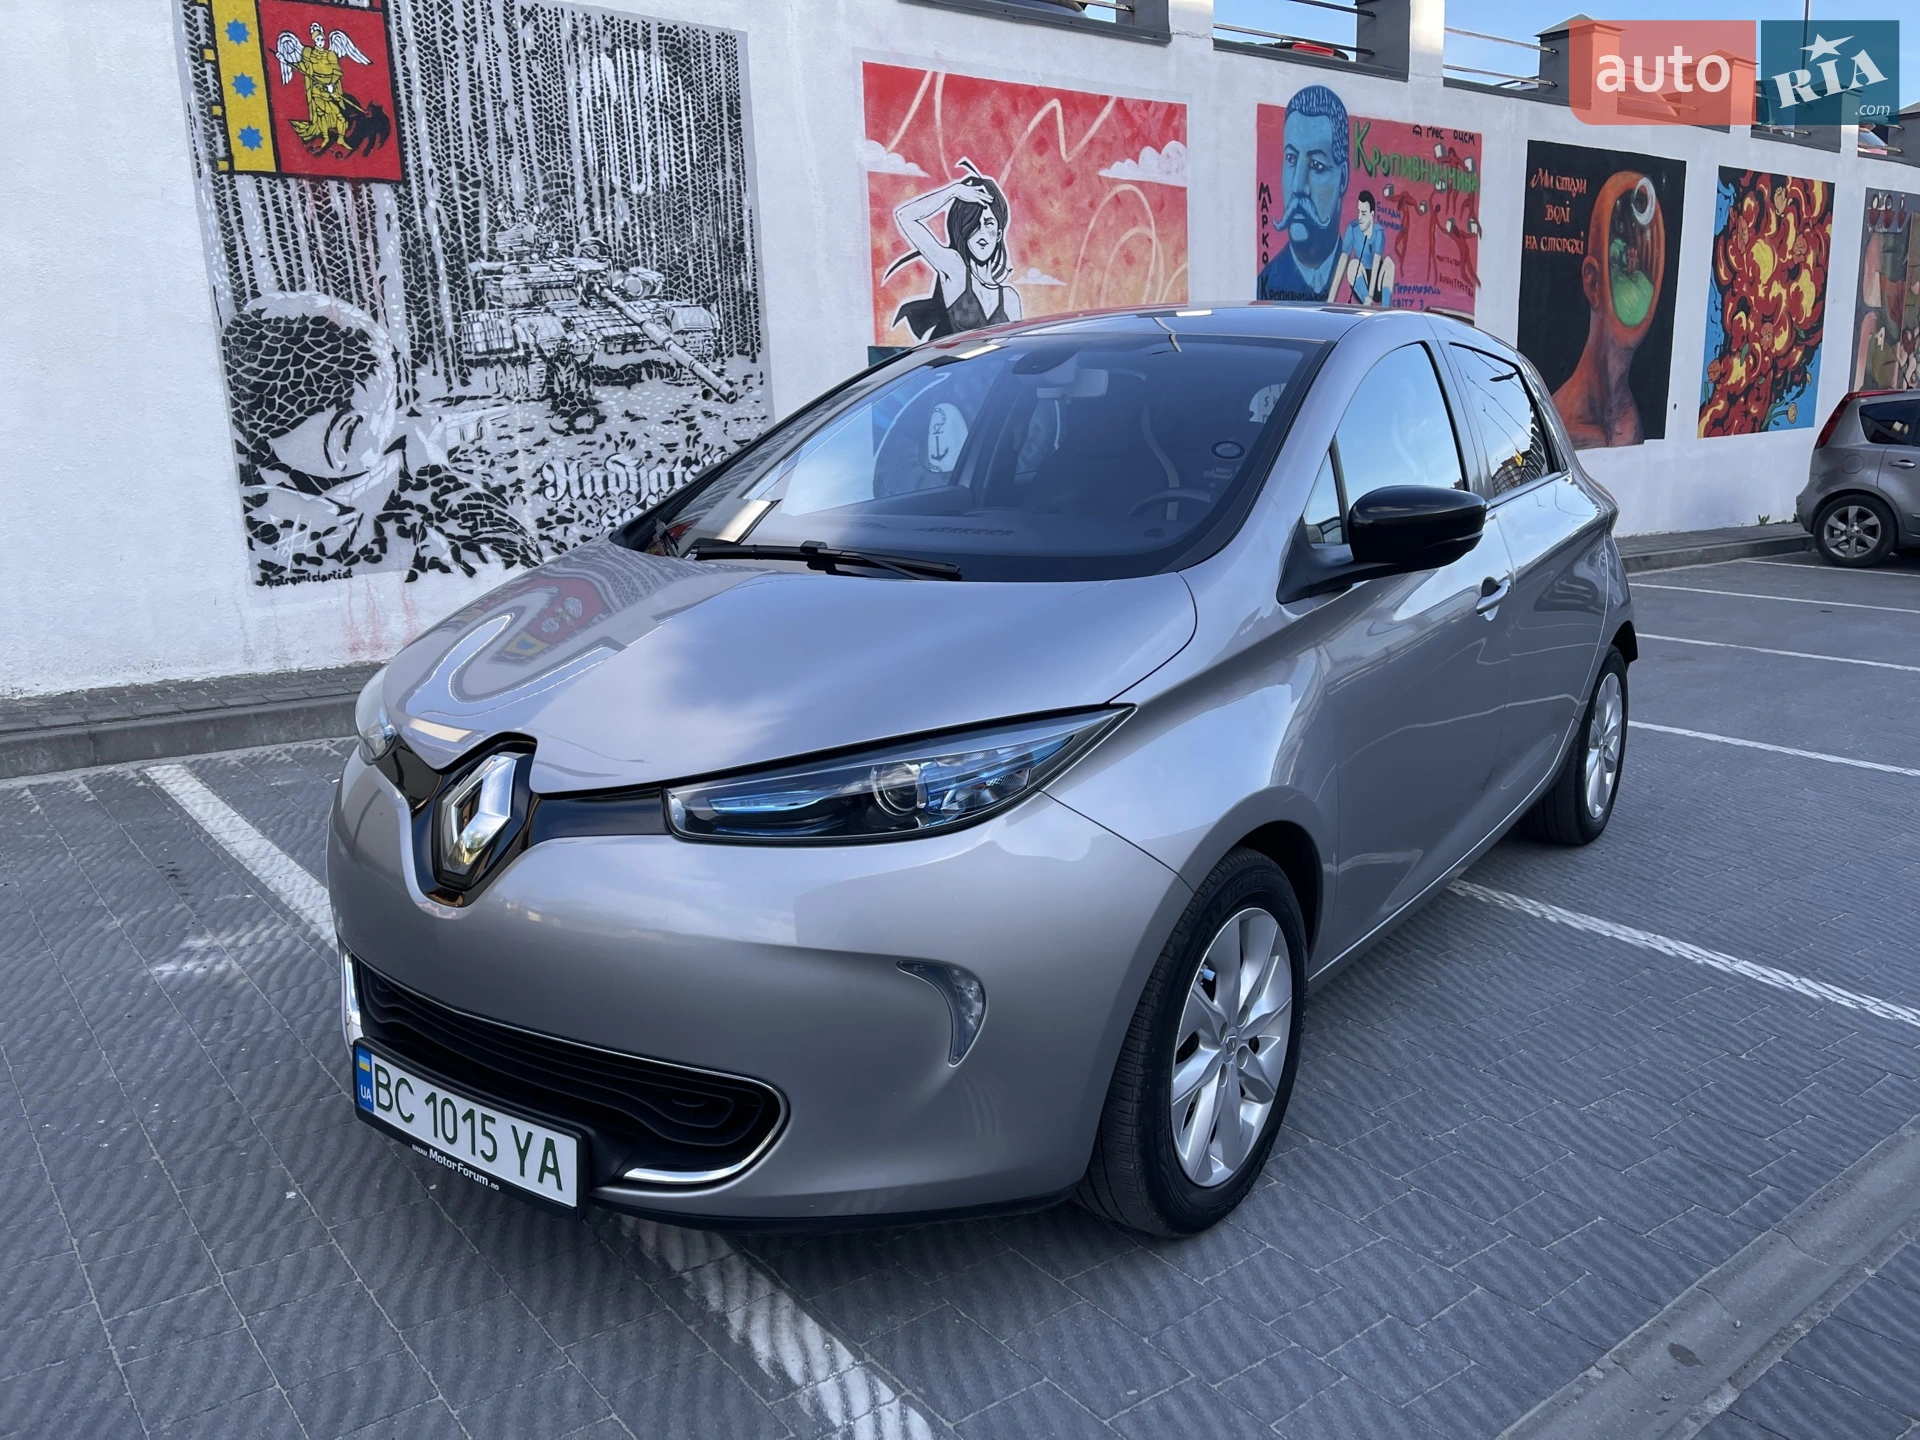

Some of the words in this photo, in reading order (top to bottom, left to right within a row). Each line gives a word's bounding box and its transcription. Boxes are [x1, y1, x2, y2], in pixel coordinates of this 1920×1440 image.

[1258, 182, 1272, 265] МАРКО
[360, 1085, 372, 1103] UA
[374, 1063, 415, 1123] BC
[424, 1091, 497, 1162] 1015
[511, 1125, 563, 1191] YA
